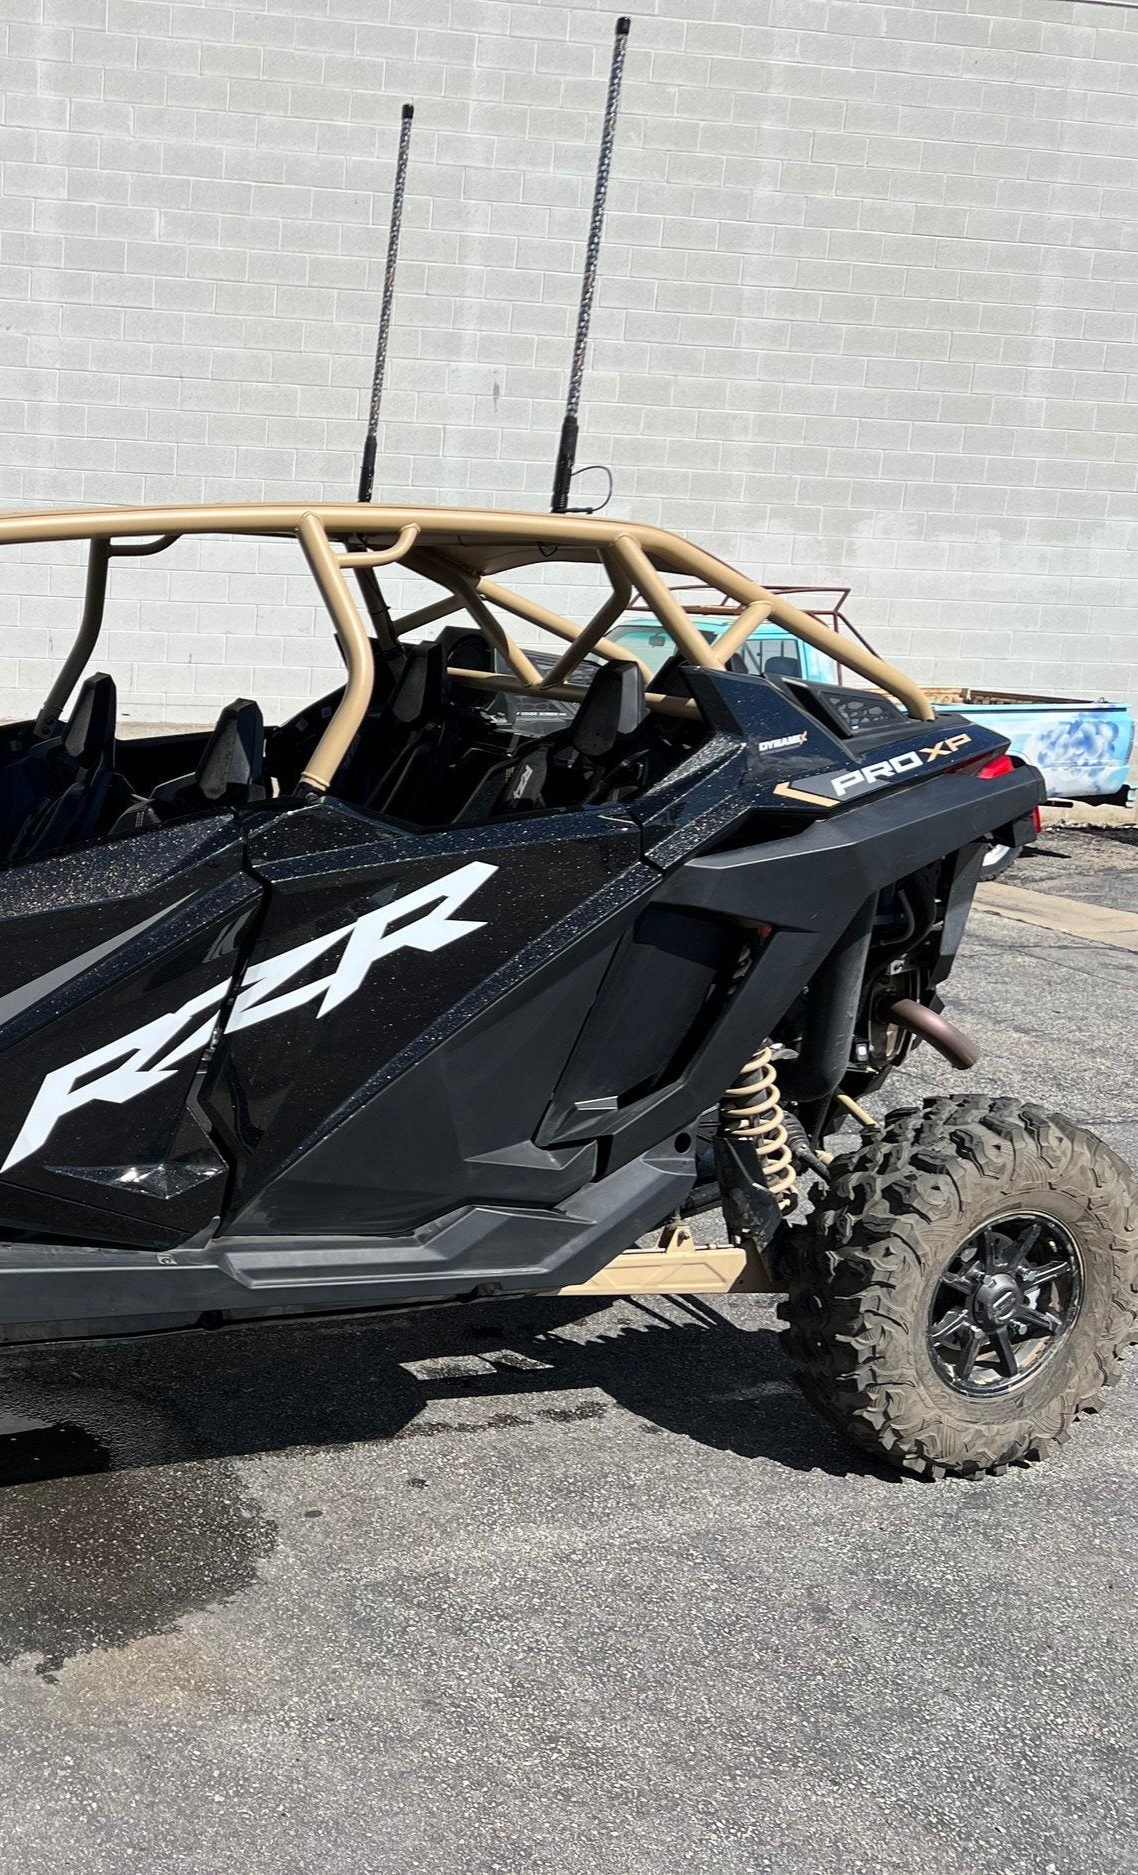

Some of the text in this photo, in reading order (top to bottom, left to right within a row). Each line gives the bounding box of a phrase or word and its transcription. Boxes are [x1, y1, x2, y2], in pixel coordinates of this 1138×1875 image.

[830, 733, 972, 797] PRO XP
[0, 861, 499, 1173] RZR
